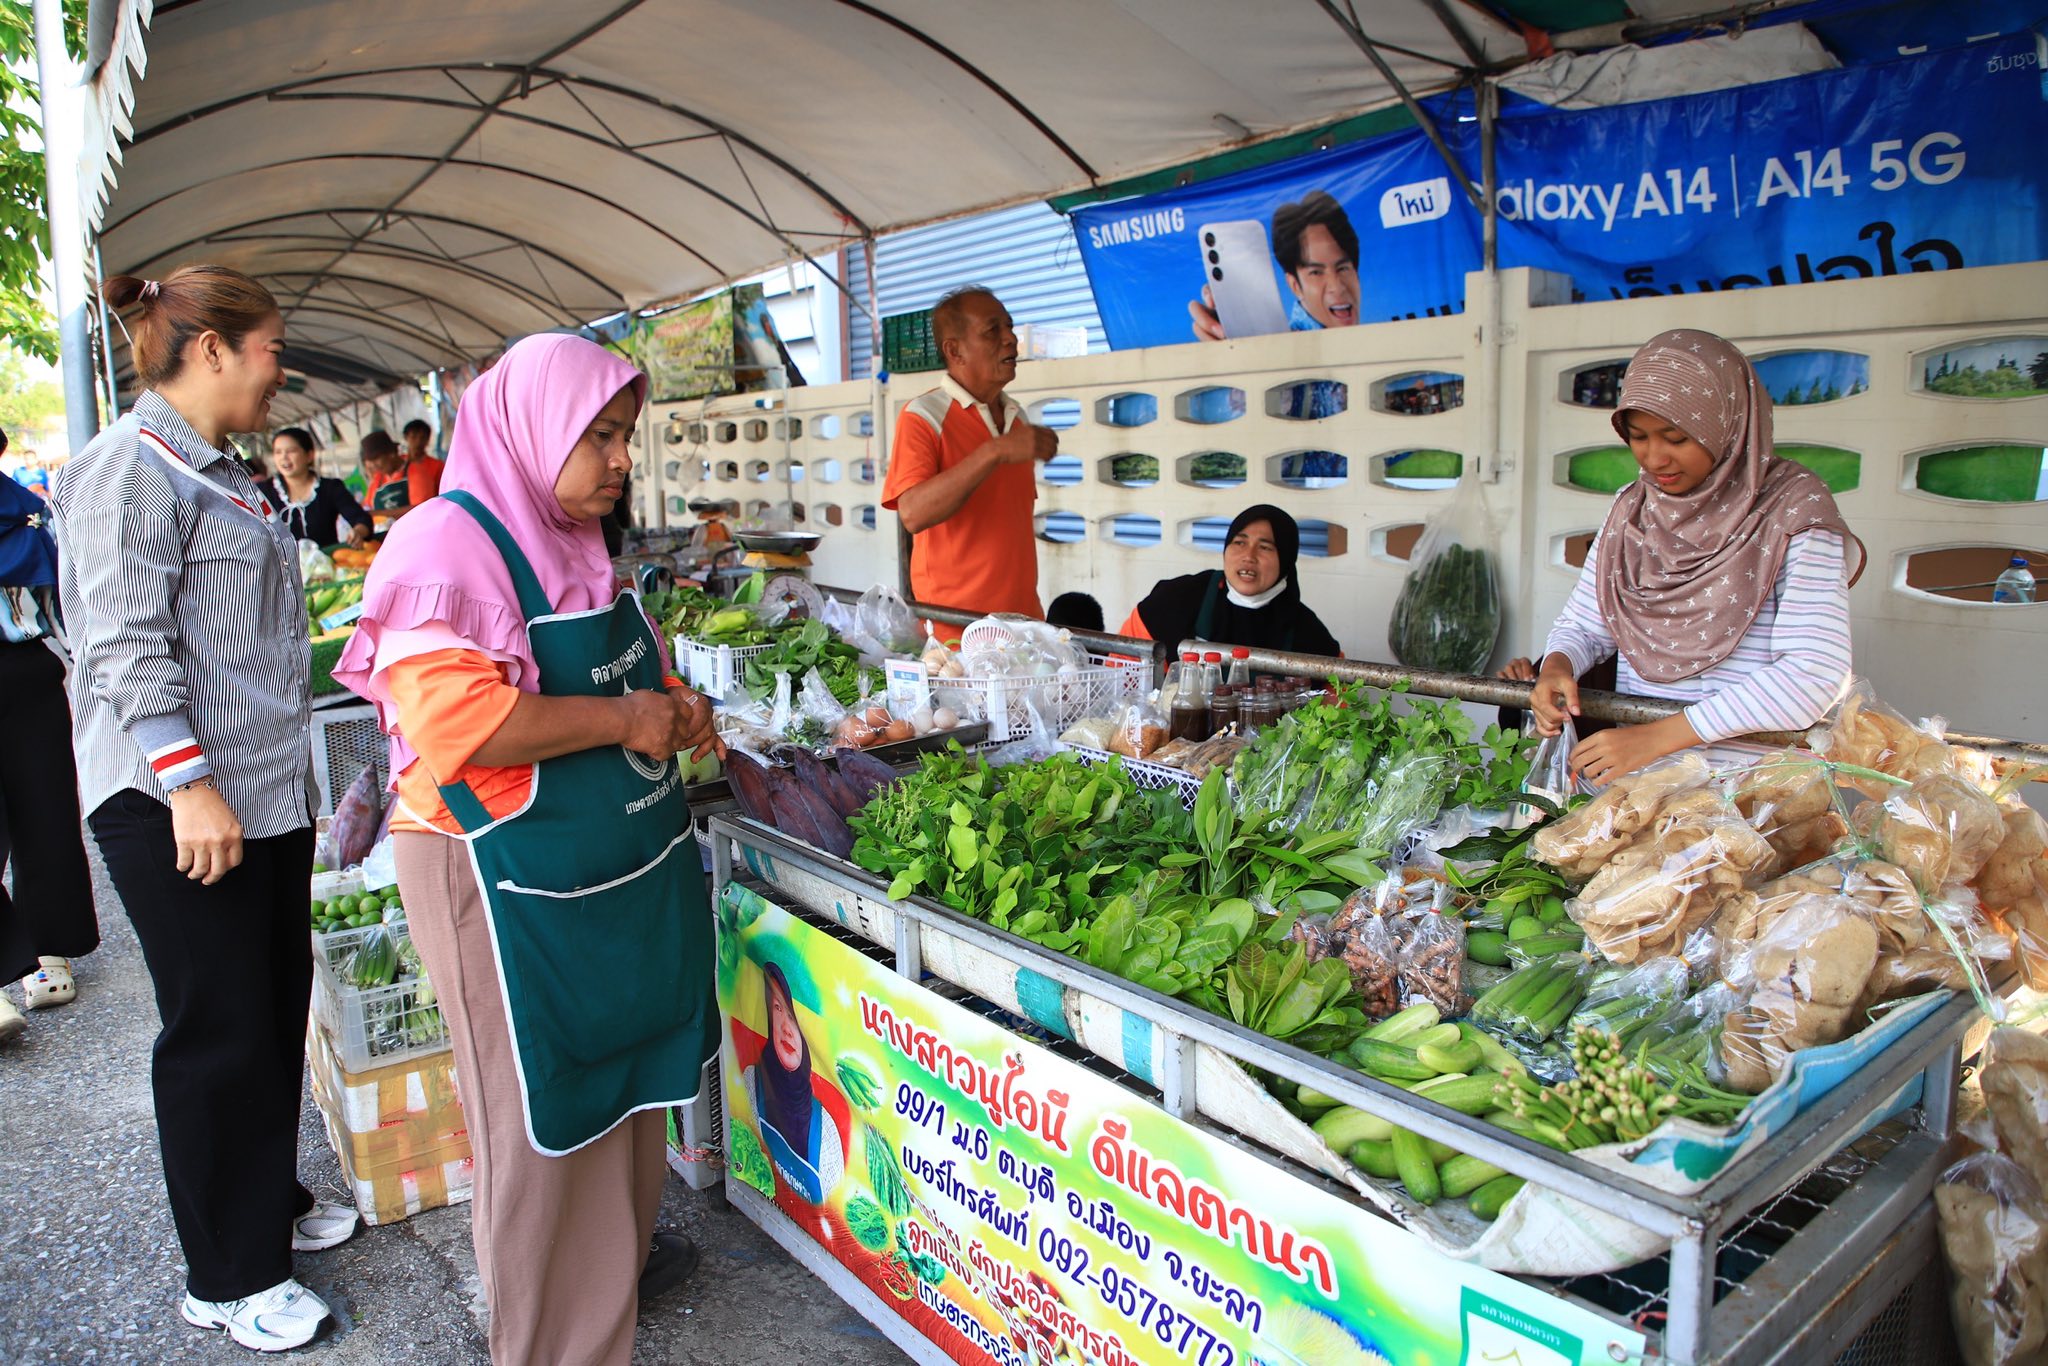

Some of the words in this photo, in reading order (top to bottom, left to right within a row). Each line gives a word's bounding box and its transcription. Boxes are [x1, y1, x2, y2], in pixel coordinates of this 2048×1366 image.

[1394, 188, 1434, 217] ใหม่
[1633, 168, 1717, 218] A14
[1758, 147, 1850, 208] A14
[1869, 132, 1966, 192] 5G
[1089, 206, 1186, 249] SAMSUNG
[896, 1083, 945, 1136] 99/1
[952, 1121, 989, 1160] ม.6
[998, 1149, 1055, 1203] ต.บุดี
[1067, 1191, 1151, 1261] อ.เมือง
[1164, 1251, 1263, 1334] จ.ยะลา
[902, 1145, 1029, 1246] เบอร์โทรศัพท์
